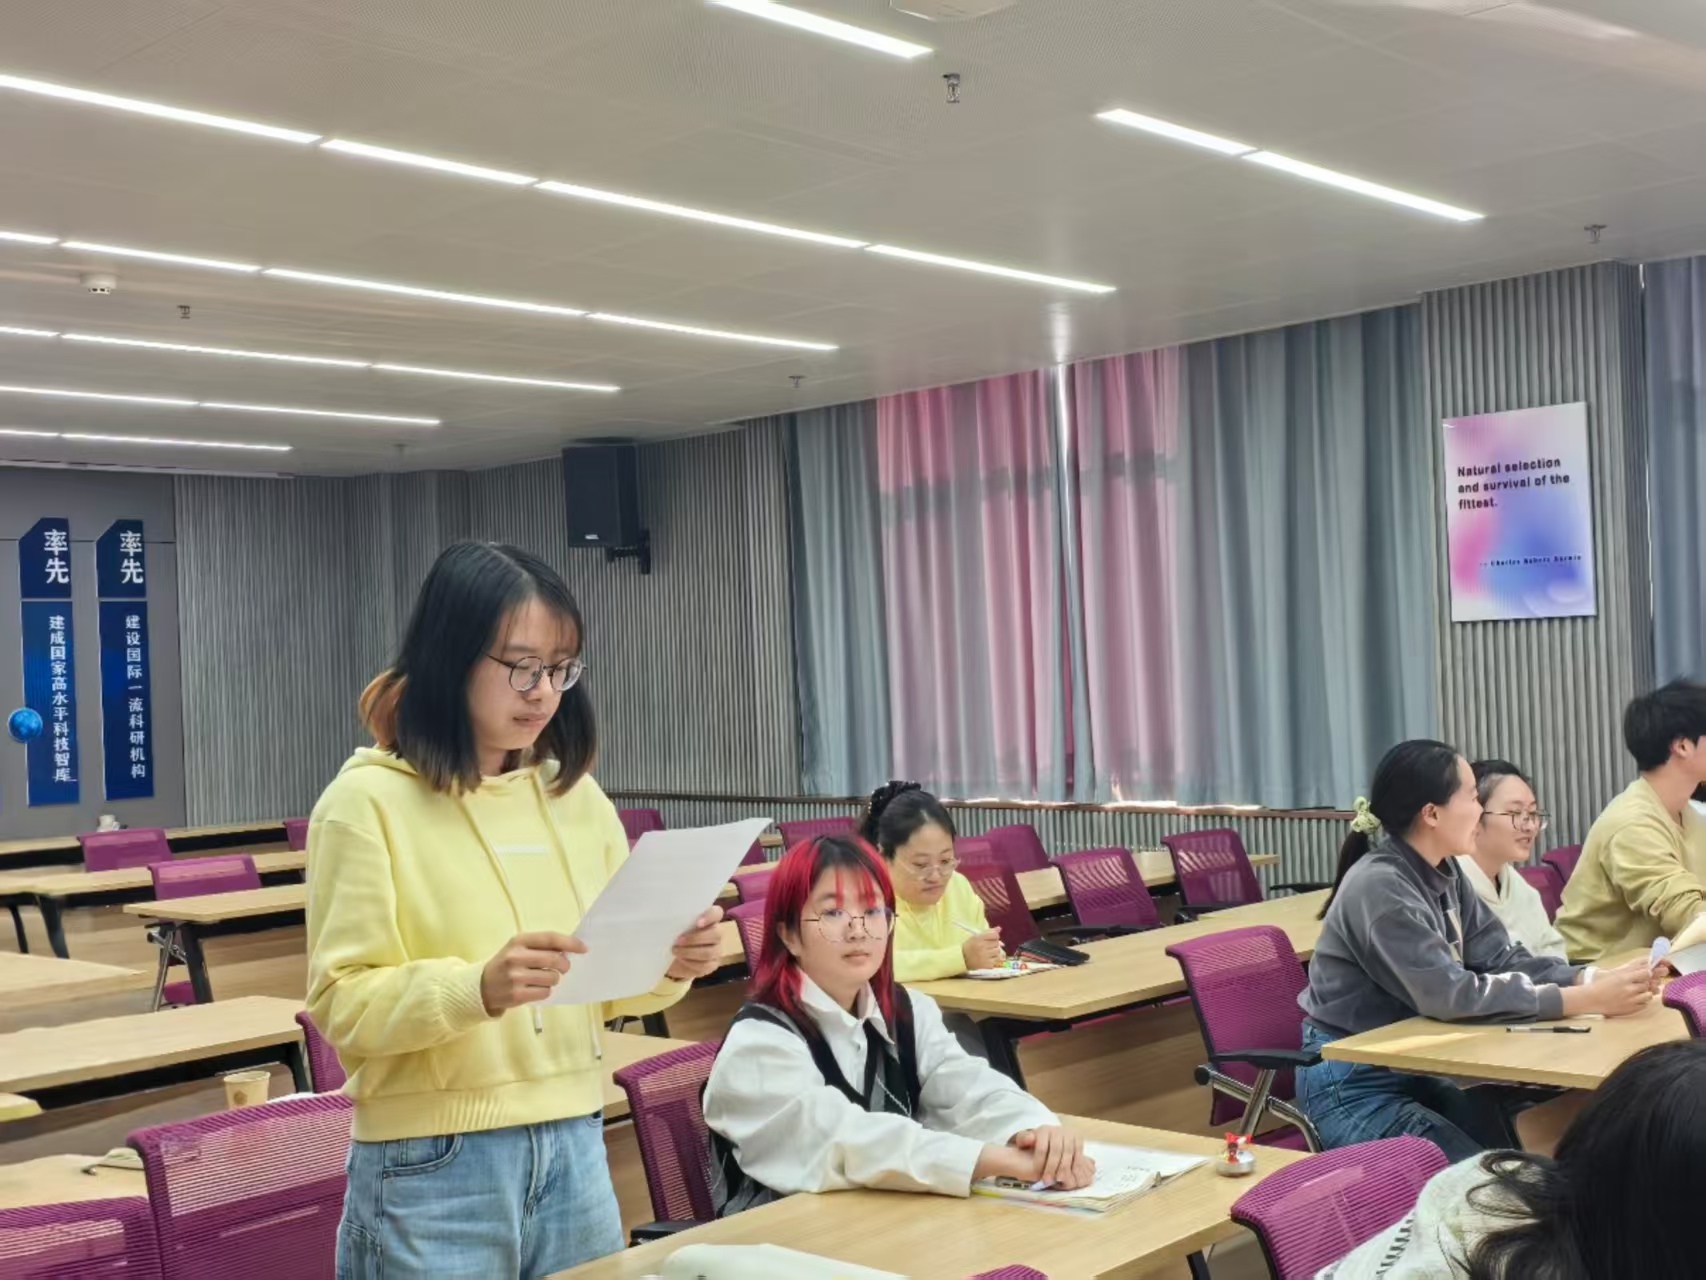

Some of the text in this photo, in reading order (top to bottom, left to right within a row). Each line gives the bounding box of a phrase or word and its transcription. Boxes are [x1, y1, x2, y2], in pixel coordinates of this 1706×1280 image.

[1457, 458, 1561, 477] Natural selection
[1458, 473, 1570, 494] and survival of the
[1459, 497, 1498, 510] fittest.
[44, 529, 69, 584] 率先
[120, 530, 144, 584] 率先
[49, 615, 71, 782] 建成国家高水平科技智库
[125, 615, 146, 779] 建设国际一流科研机构
